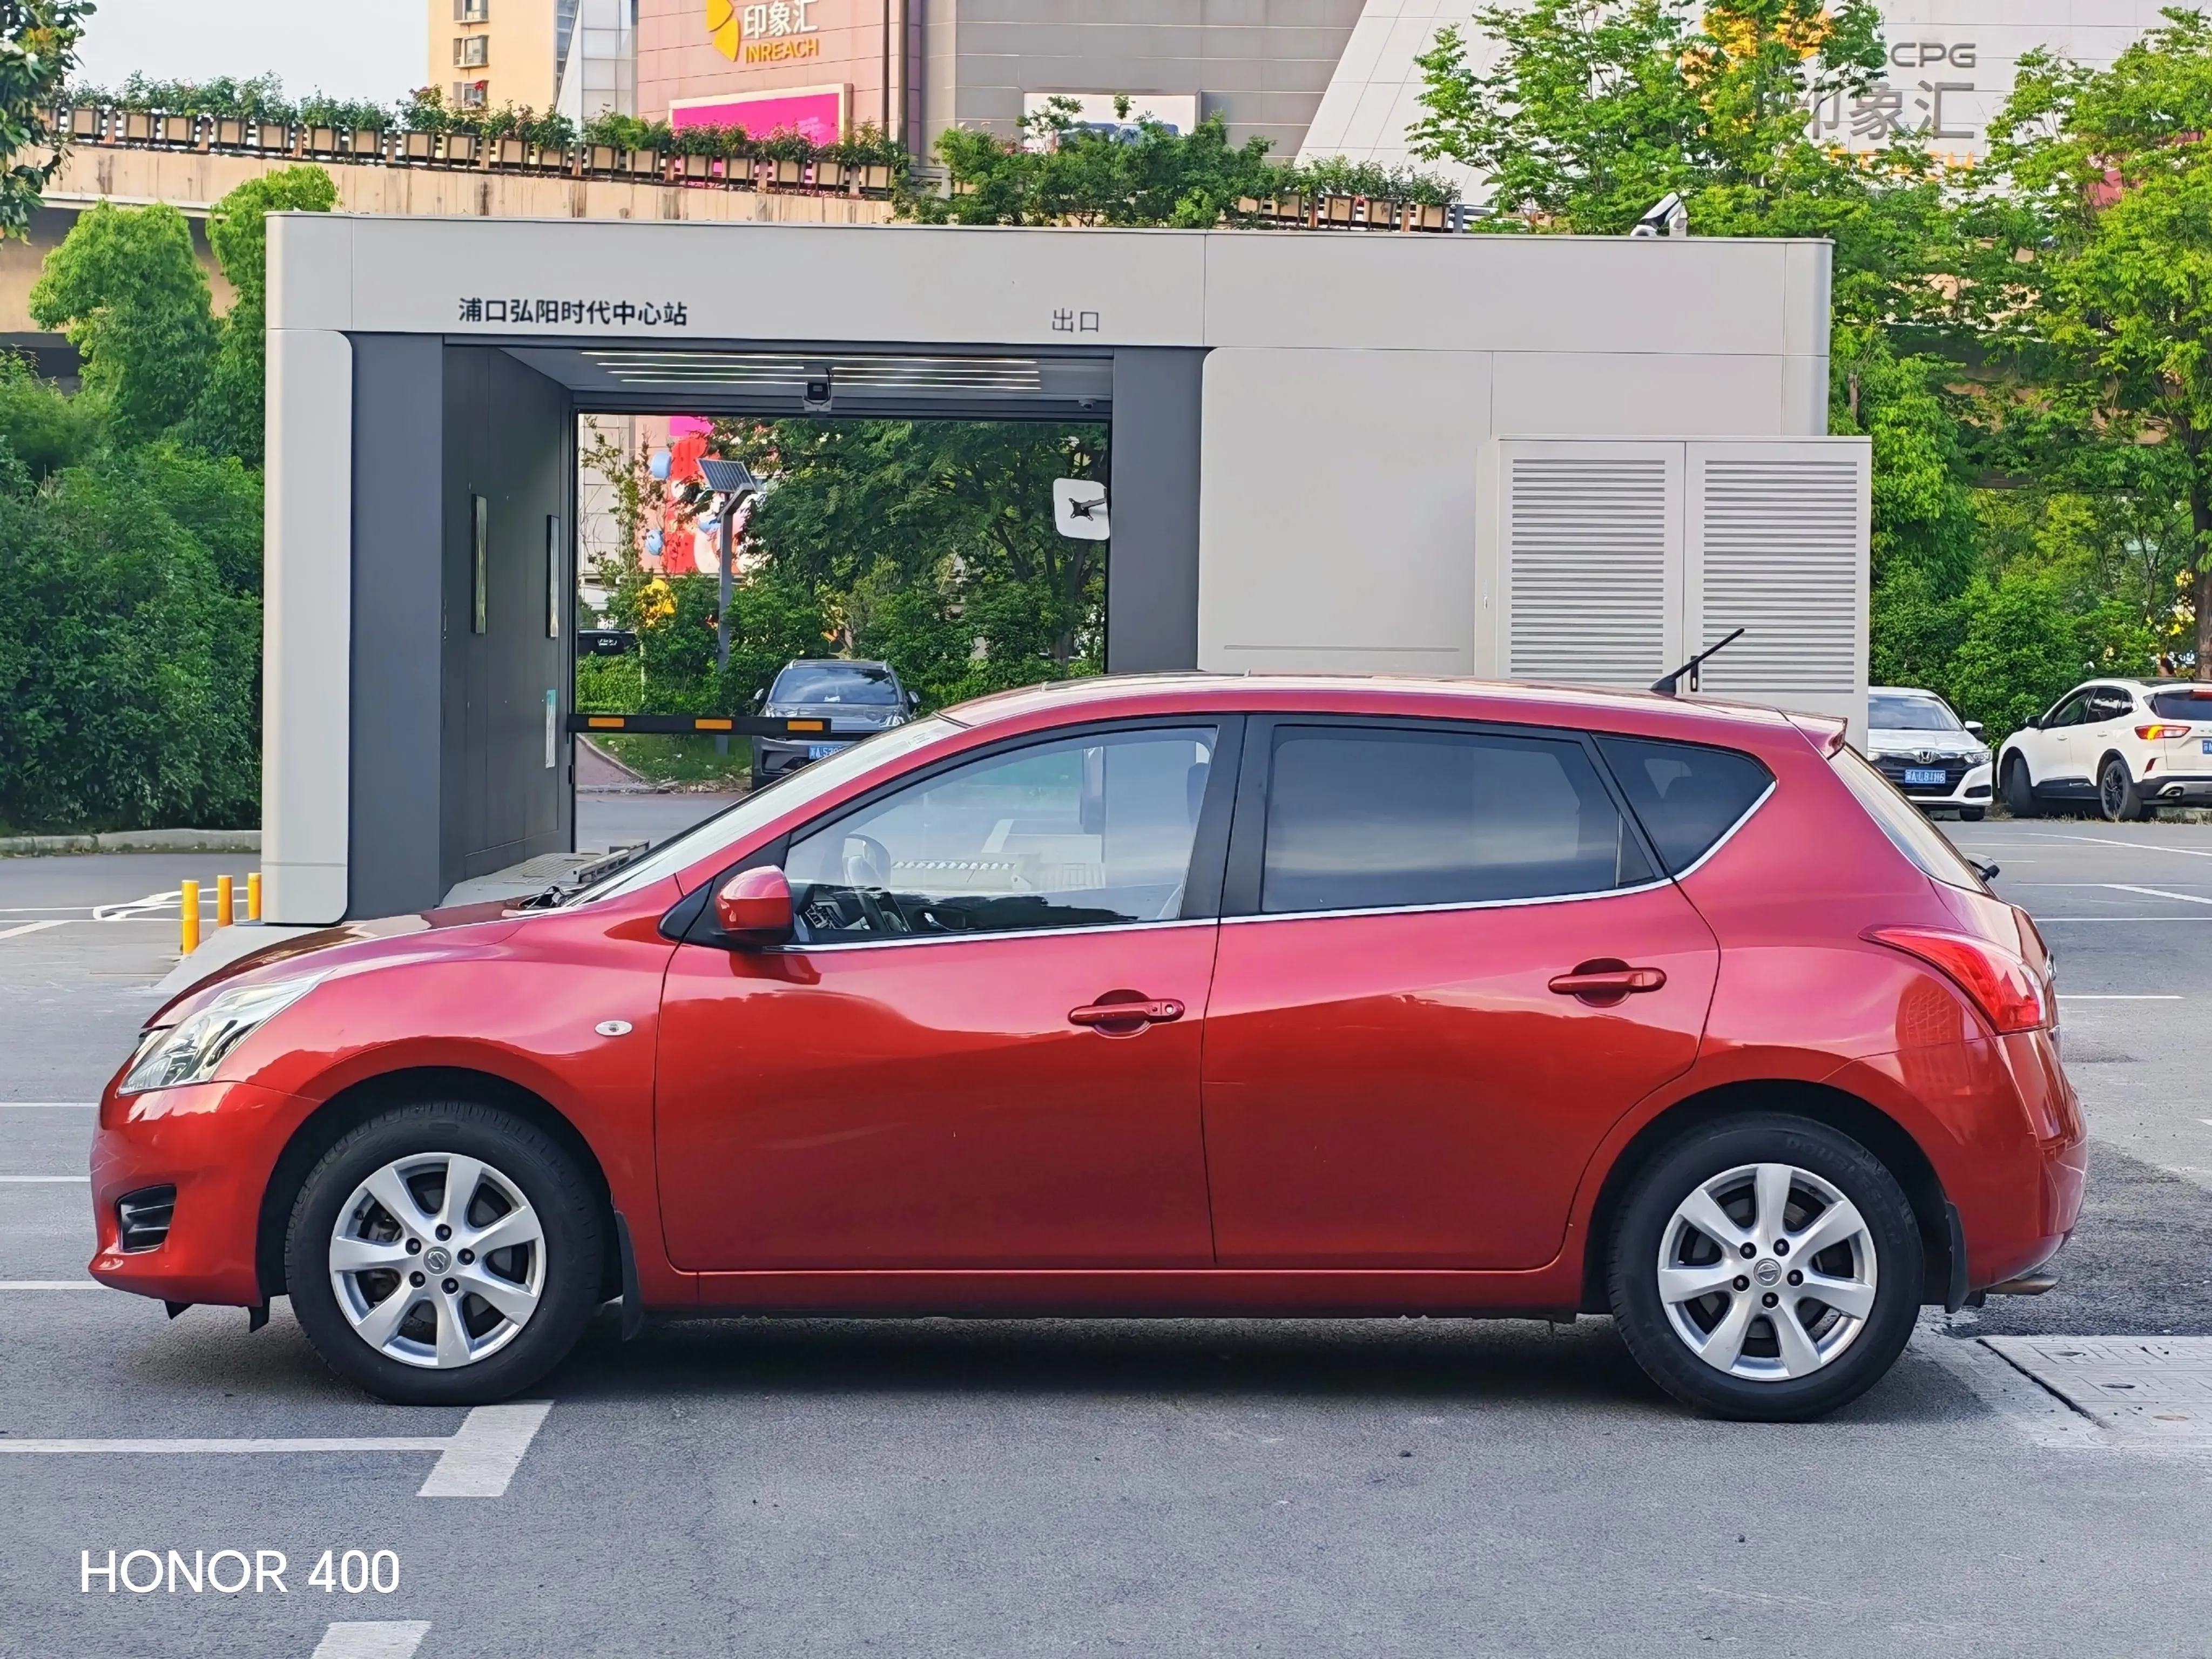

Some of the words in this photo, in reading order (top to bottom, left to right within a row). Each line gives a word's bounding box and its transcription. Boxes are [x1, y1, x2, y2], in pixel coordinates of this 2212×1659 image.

[744, 0, 819, 39] 印象汇
[745, 38, 820, 64] INREACH
[1884, 42, 1977, 69] CPG
[458, 297, 687, 326] 浦口弘阳时代中心站
[1052, 307, 1099, 333] 出口
